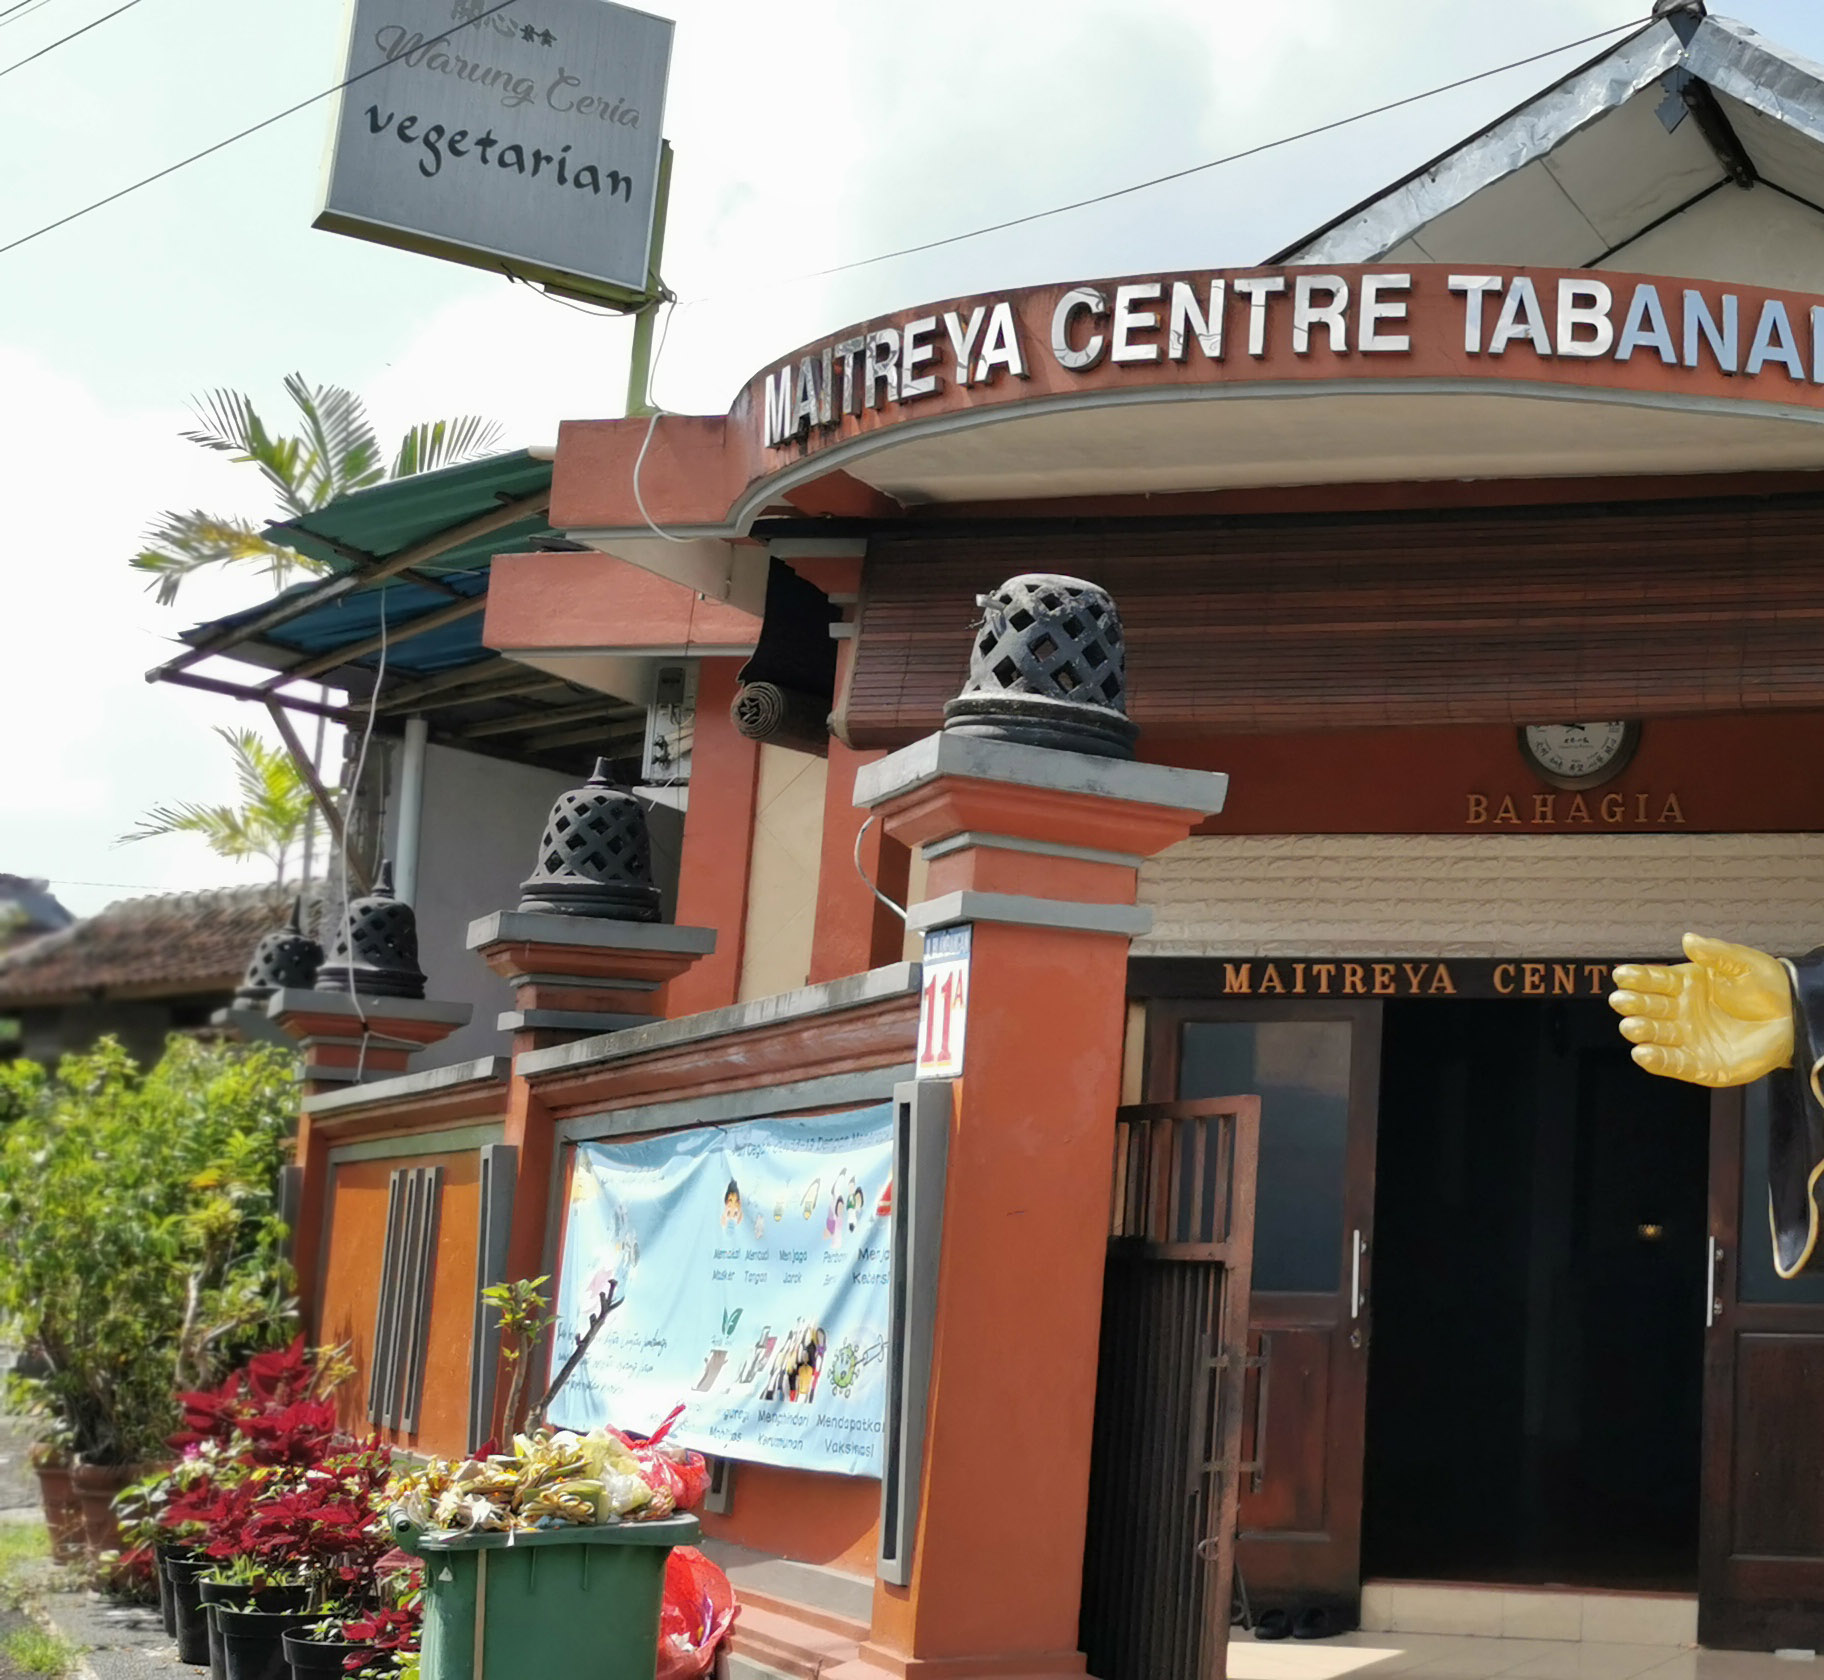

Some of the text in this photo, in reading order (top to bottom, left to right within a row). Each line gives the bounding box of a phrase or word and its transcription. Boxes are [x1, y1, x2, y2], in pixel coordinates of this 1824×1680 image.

[374, 25, 641, 129] Warung Ceria
[364, 104, 633, 204] vegetarian
[764, 302, 1030, 450] MAITREYA
[1051, 273, 1412, 372] CENTRE
[1466, 793, 1687, 825] BAHAGIA
[1222, 963, 1669, 996] MAITREYA CENT
